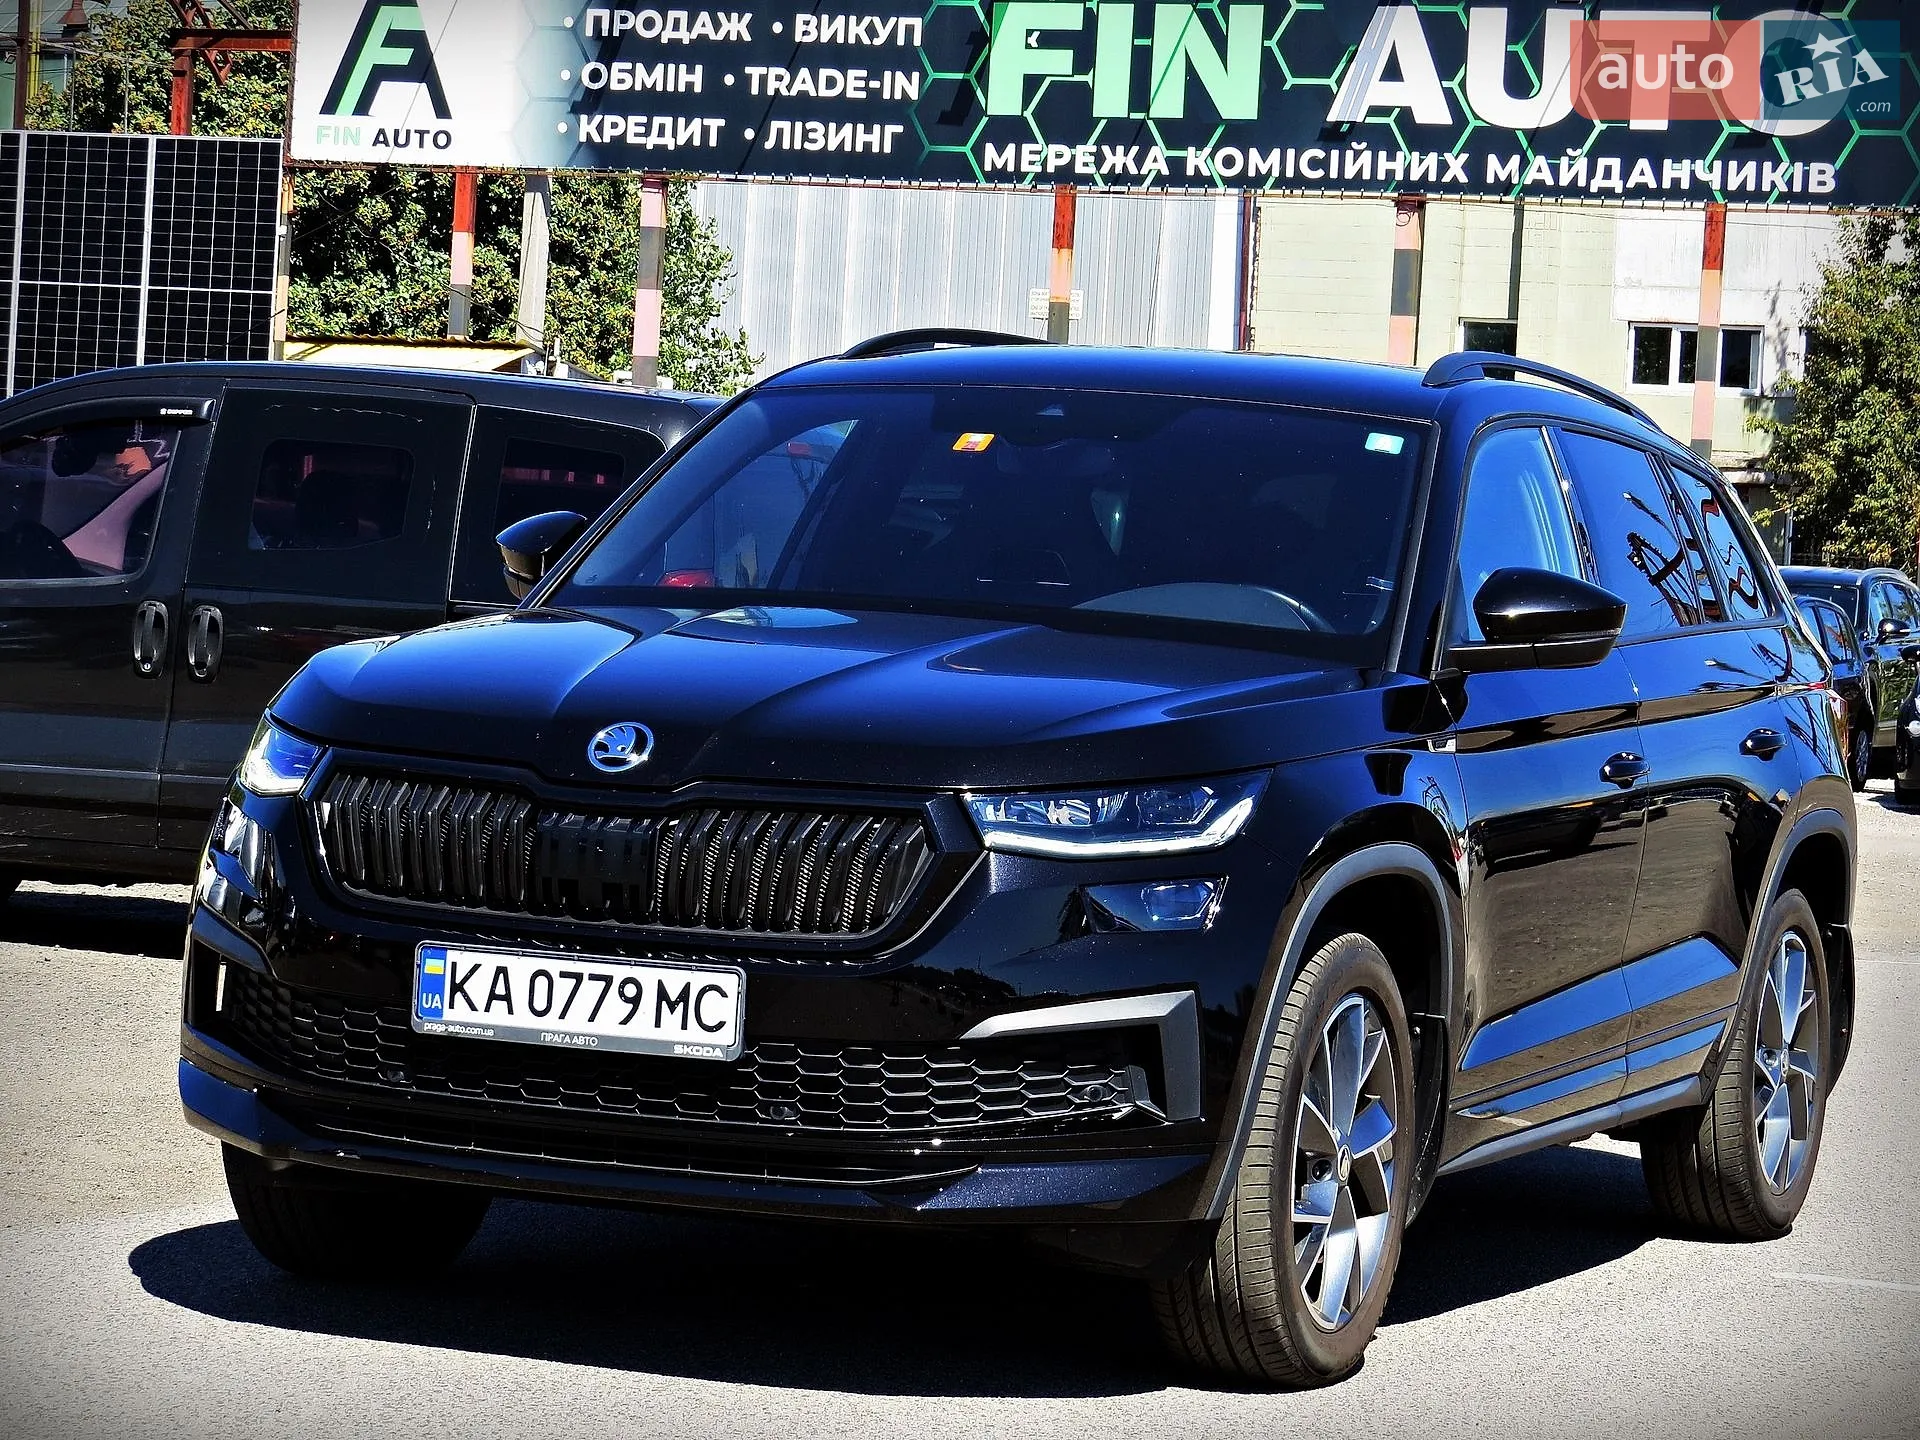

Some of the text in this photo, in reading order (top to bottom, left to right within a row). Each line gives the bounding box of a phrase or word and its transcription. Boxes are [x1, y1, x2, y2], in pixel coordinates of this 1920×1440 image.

[585, 8, 752, 43] ПРОДАЖ
[795, 13, 923, 47] ВИКУП
[581, 61, 703, 92] ОБМІН
[745, 65, 920, 101] TRADE-IN
[986, 2, 1855, 136] FIN AUTO
[317, 125, 452, 149] FIN AUTO
[579, 114, 726, 150] КРЕДИТ
[764, 120, 904, 154] ЛІЗИНГ
[984, 142, 1837, 193] МЕРЕЖА КОМІСІЙНИХ МАЙДАНЧИКІВ
[422, 993, 442, 1009] UA
[449, 962, 728, 1032] KA 0779 MC
[541, 1032, 598, 1047] ПРАГА АВТО
